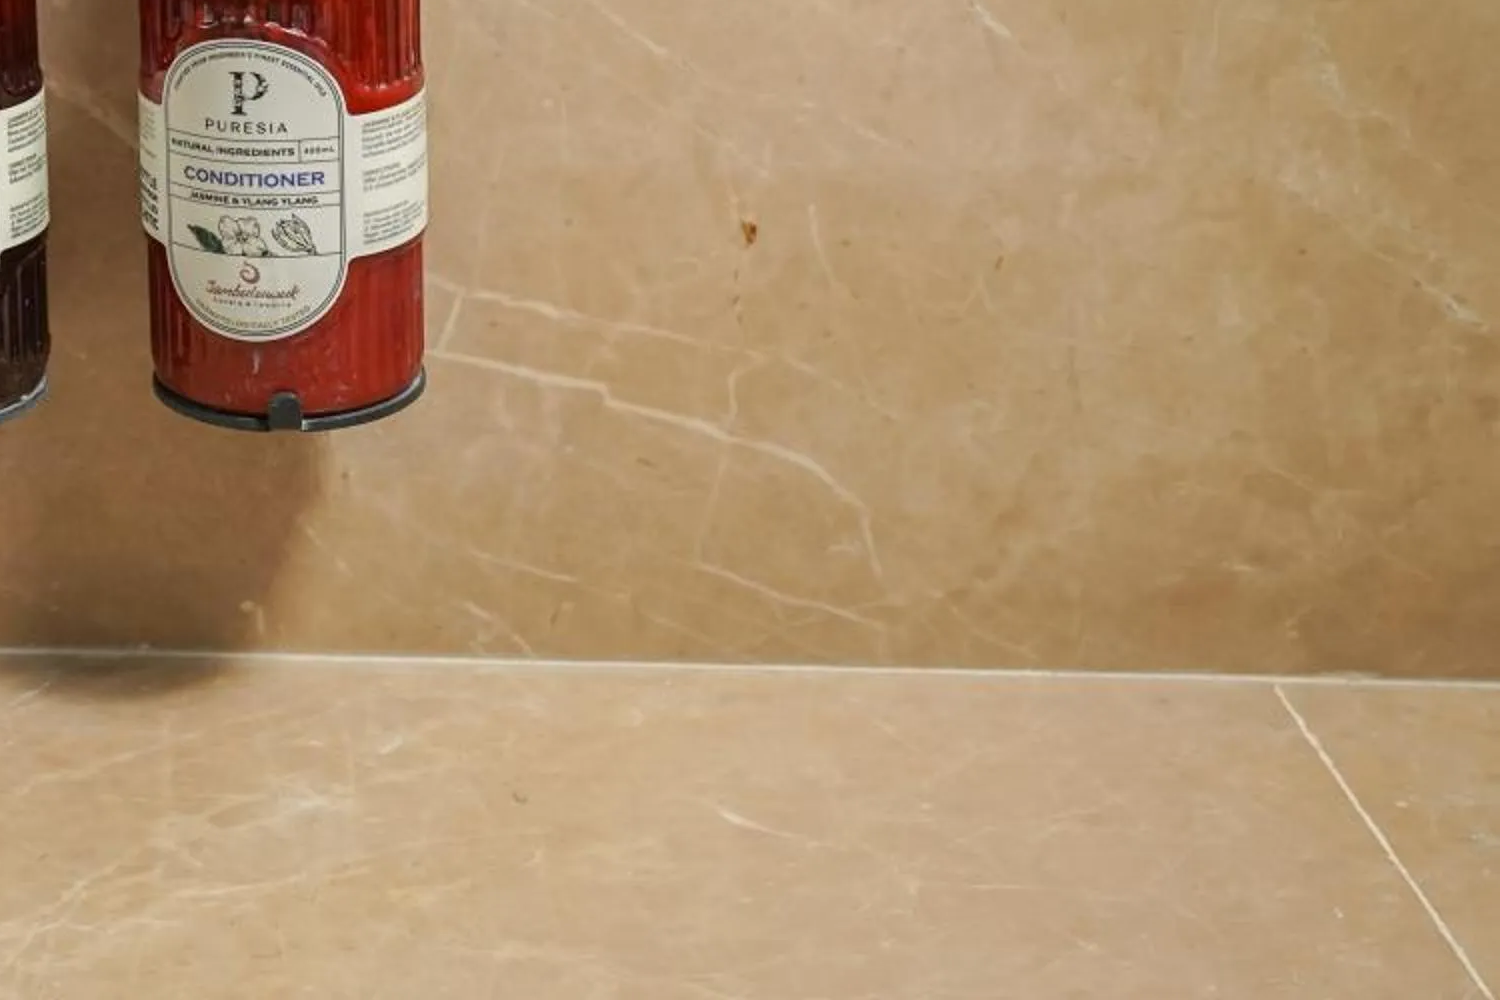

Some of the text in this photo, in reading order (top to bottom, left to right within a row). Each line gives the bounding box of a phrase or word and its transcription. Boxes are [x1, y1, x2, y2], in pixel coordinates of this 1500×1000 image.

[228, 71, 269, 116] P
[205, 118, 288, 135] PURESIA
[171, 137, 213, 153] NATURAL
[215, 145, 295, 157] INGREDIENTS
[183, 165, 325, 188] CONDITIONER
[191, 192, 319, 207] JASMINE & YLANG YLANG
